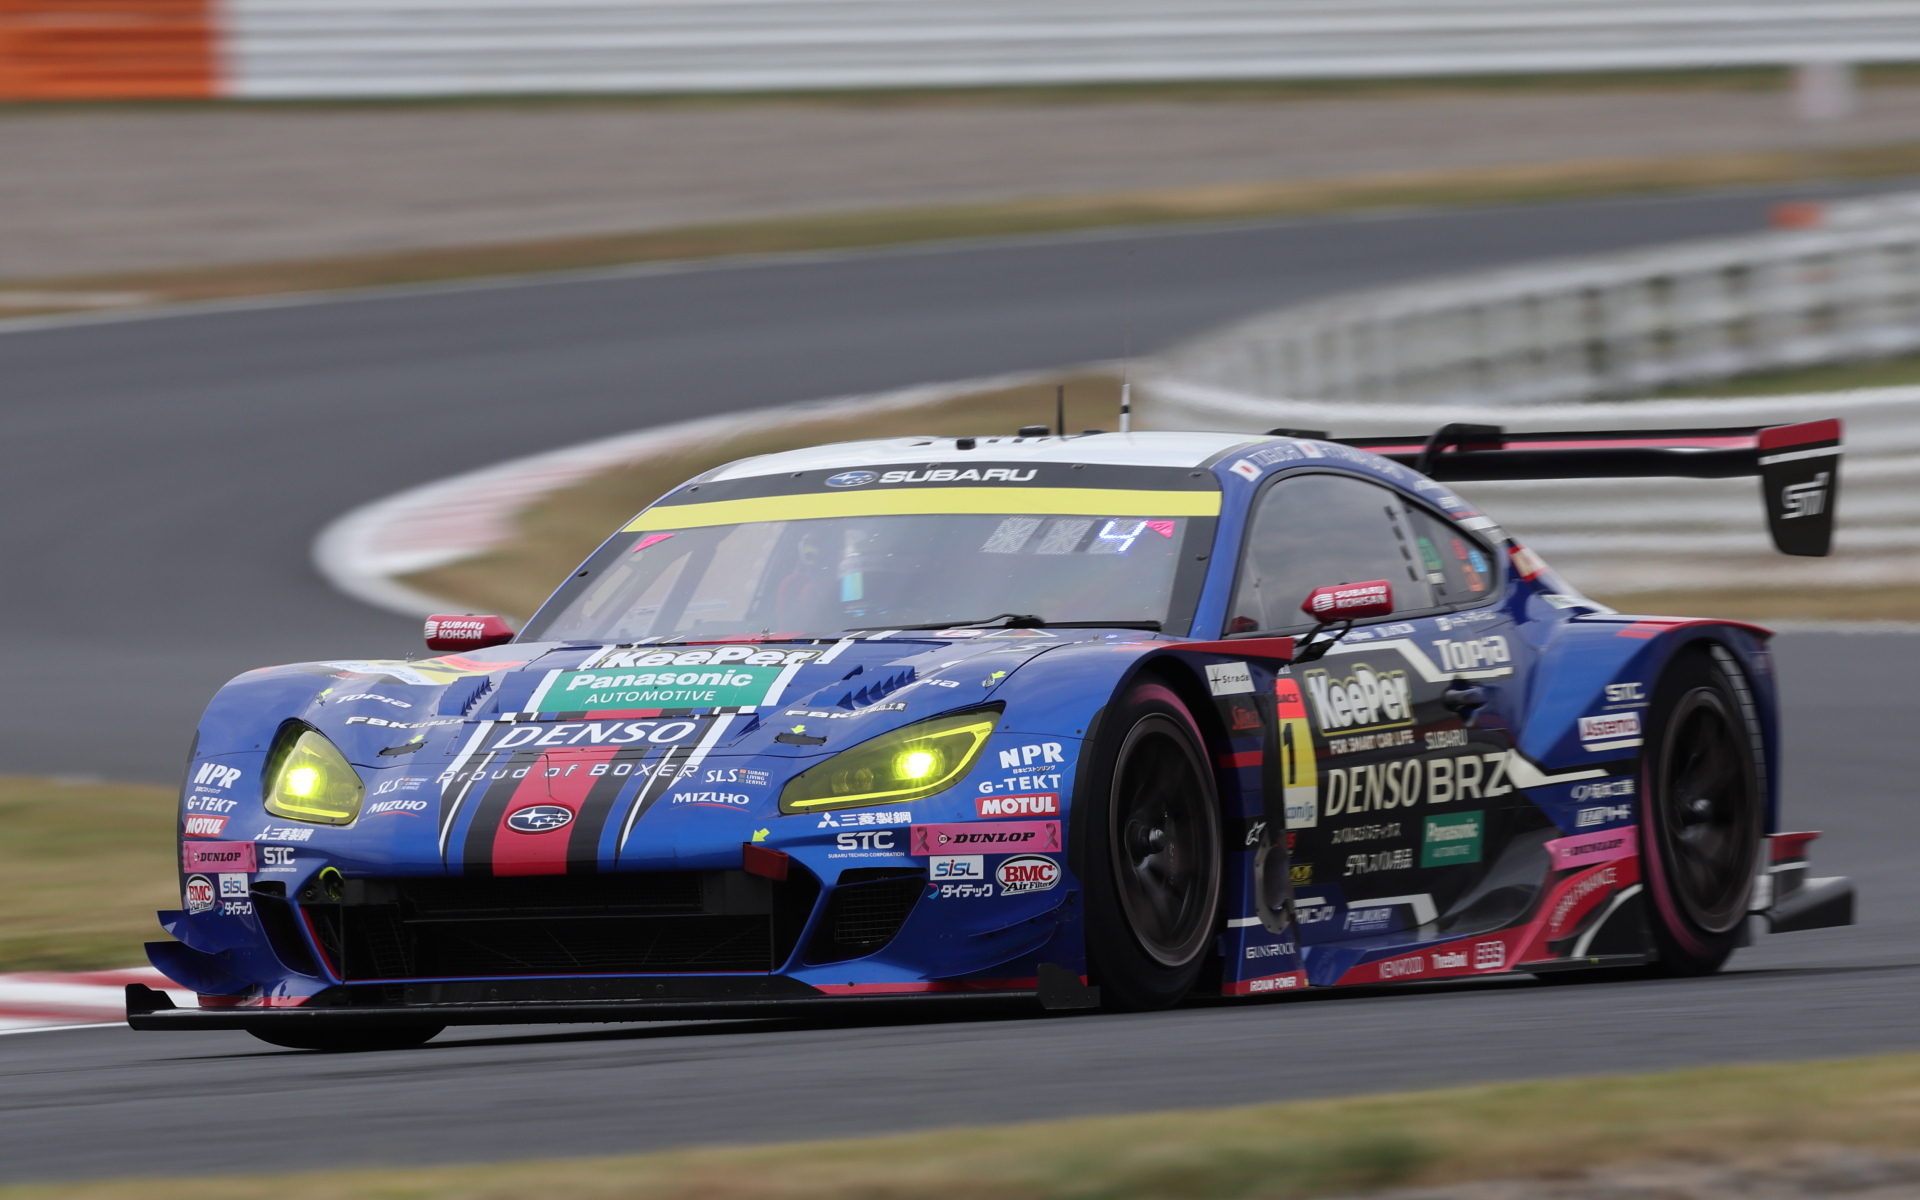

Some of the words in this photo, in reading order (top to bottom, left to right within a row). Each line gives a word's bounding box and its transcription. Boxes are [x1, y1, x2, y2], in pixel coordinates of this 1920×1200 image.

[879, 468, 1038, 484] SUBARU
[1099, 520, 1148, 555] 4
[1334, 585, 1386, 599] SUBARU
[1336, 594, 1388, 609] KOHSAN
[440, 620, 485, 630] SUBARU
[438, 629, 482, 639] KOHSAN
[602, 647, 816, 669] KeePer
[566, 669, 754, 691] Panasonic
[584, 691, 717, 704] AUTOMOTIVE
[1307, 669, 1411, 730] KeePer
[345, 716, 410, 729] FBK
[784, 710, 850, 719] FBK
[491, 721, 696, 749] DENSO
[1329, 738, 1349, 754] FOR
[1349, 734, 1376, 751] SMART
[1376, 732, 1394, 749] CAR
[1394, 730, 1415, 747] LIFE
[1424, 729, 1468, 750] SUBARU
[999, 742, 1064, 769] NPR
[1282, 722, 1296, 785] 1
[194, 762, 241, 788] NPR
[435, 765, 532, 784] Proud
[543, 763, 579, 778] of
[588, 763, 700, 778] BOXER
[705, 769, 738, 783] SLS
[1013, 765, 1055, 774] 日本ピストンリング
[373, 778, 404, 795] SLS
[979, 774, 1061, 793] G-TEKT
[1324, 758, 1422, 816] DENSO
[1426, 752, 1512, 804] BRZ
[187, 795, 238, 812] G-TEKT
[366, 800, 428, 814] MIZUHO
[672, 792, 749, 805] MIZUHO
[981, 797, 1056, 815] MOTUL
[185, 818, 224, 834] MOTUL
[840, 811, 912, 826] 三菱製鋼
[953, 832, 1036, 844] DUNLOP
[1426, 817, 1479, 842] Panasonic
[837, 831, 895, 851] STC
[200, 852, 242, 862] DUNLOP
[263, 846, 296, 865] STC
[1004, 865, 1053, 883] BMC
[189, 885, 211, 902] BMC
[940, 884, 993, 898] ダイテック
[1005, 882, 1028, 892] Air
[1028, 881, 1050, 890] Filter
[224, 902, 252, 915] ダイテック
[1379, 956, 1424, 979] KENWOOD
[1431, 951, 1468, 969] ThreeBond
[1250, 978, 1274, 991] IRIDIUM
[1275, 976, 1297, 988] POWER
